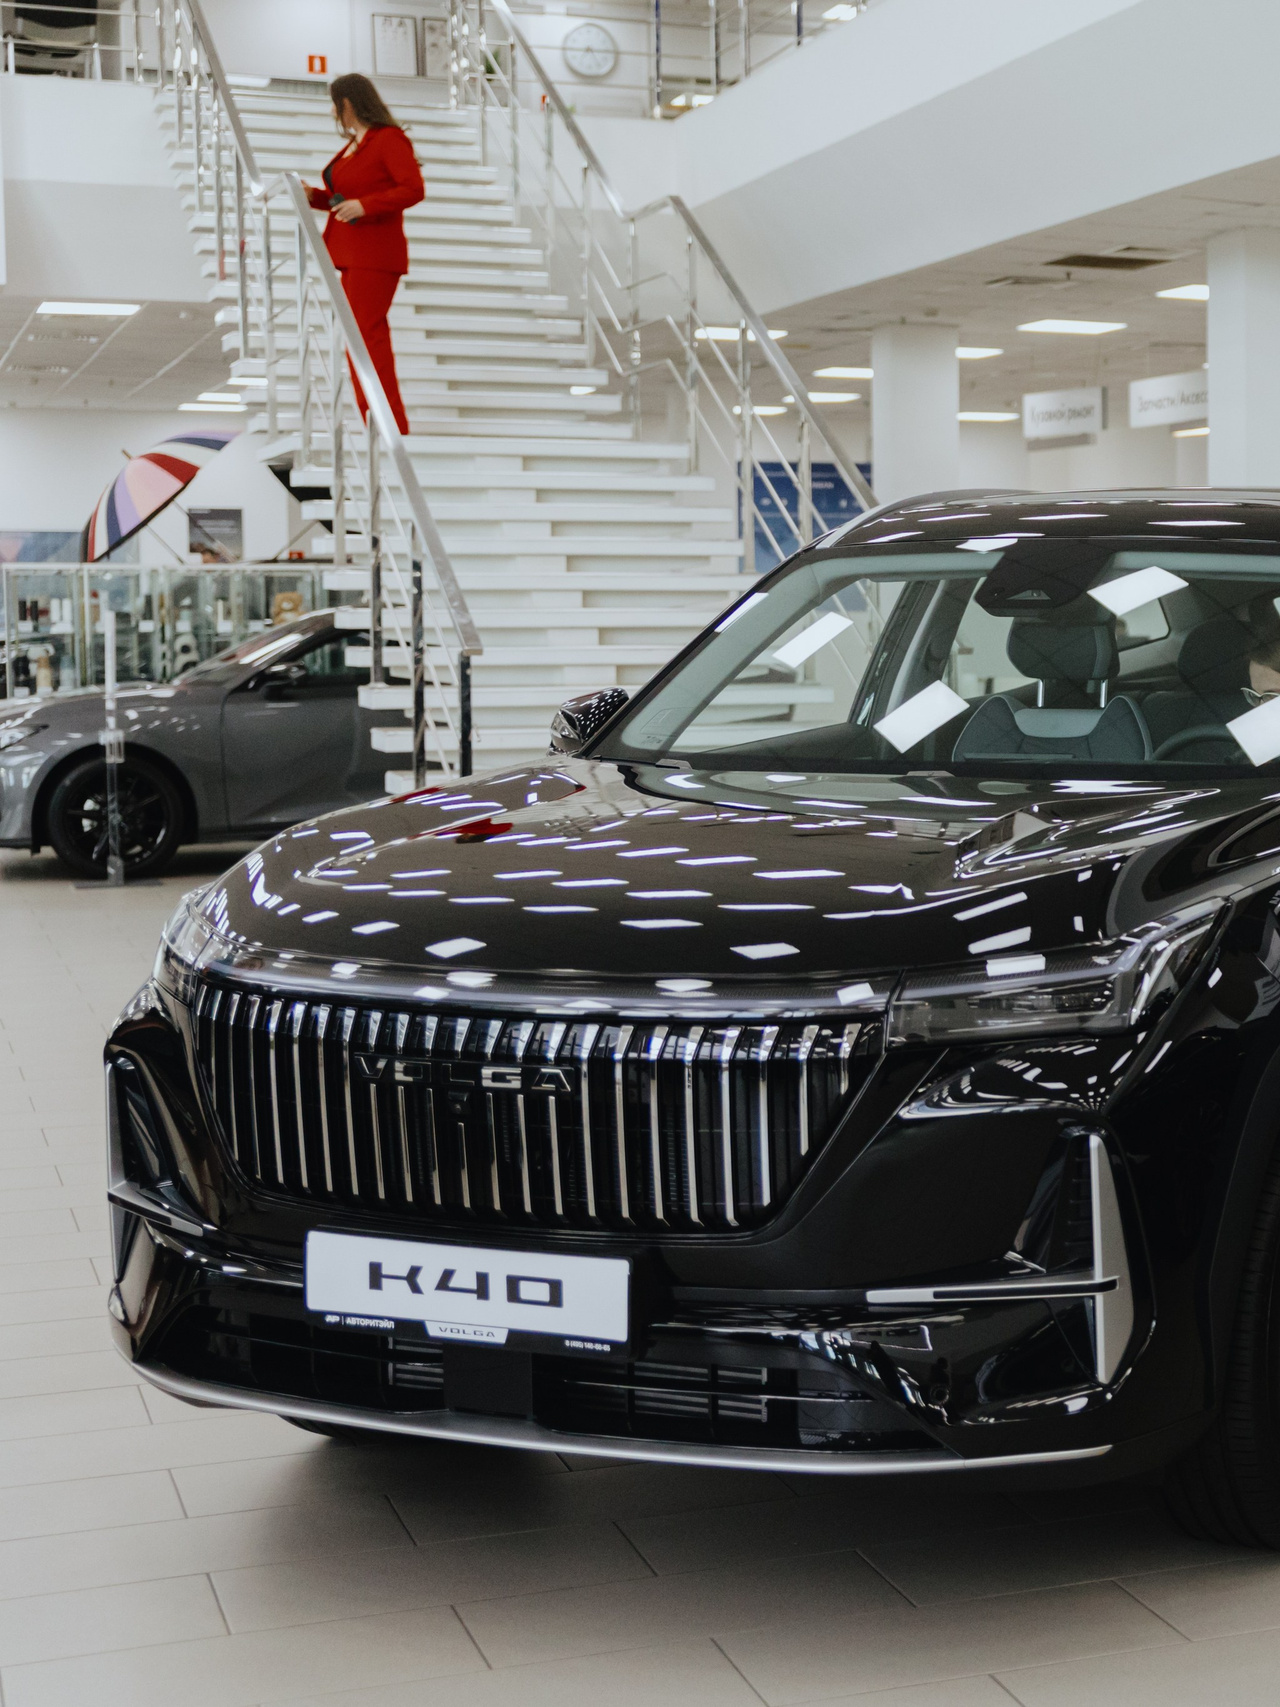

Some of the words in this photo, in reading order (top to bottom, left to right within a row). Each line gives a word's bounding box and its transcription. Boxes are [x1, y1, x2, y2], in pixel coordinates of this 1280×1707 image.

[354, 1053, 571, 1092] VOLGA
[368, 1261, 563, 1308] K40
[345, 1316, 395, 1329] АВТОРИТЭЙЛ
[438, 1326, 496, 1338] VOLGA
